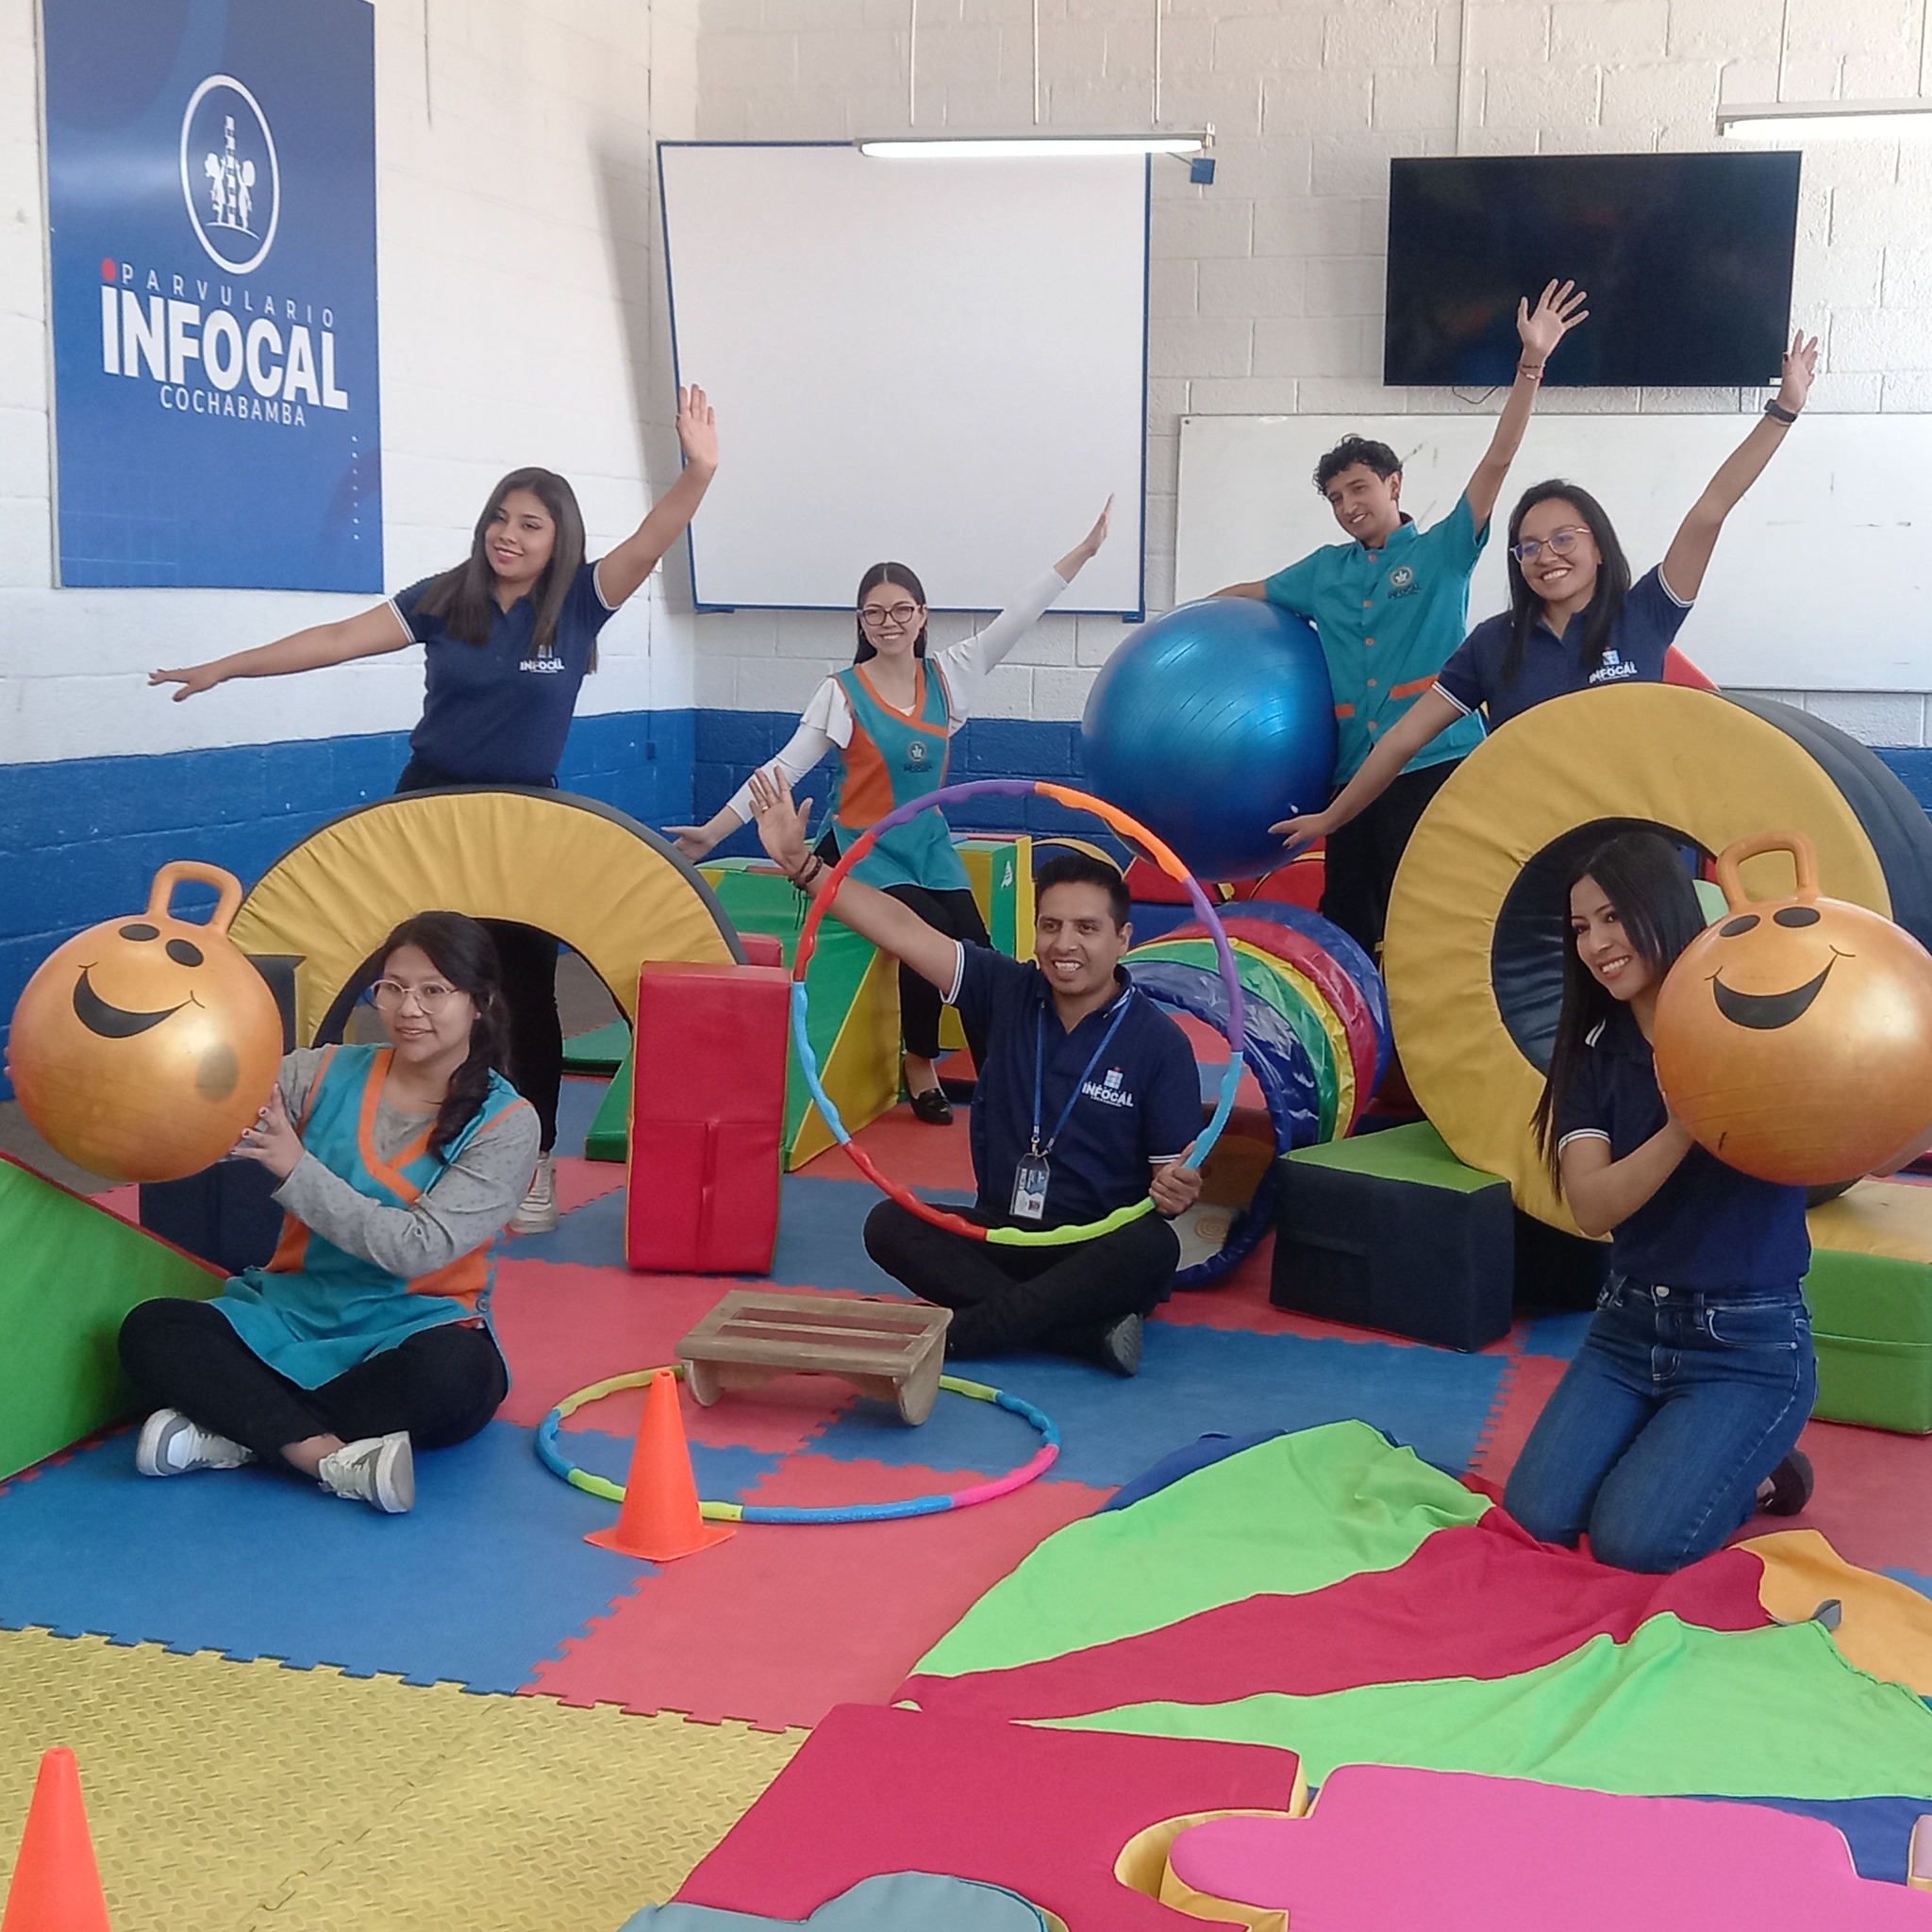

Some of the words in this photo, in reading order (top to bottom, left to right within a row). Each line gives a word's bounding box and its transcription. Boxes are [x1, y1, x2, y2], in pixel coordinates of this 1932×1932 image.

[122, 263, 334, 328] PARVULARIO
[159, 385, 306, 427] COCHABAMBA
[1081, 1082, 1134, 1108] INFOCAL
